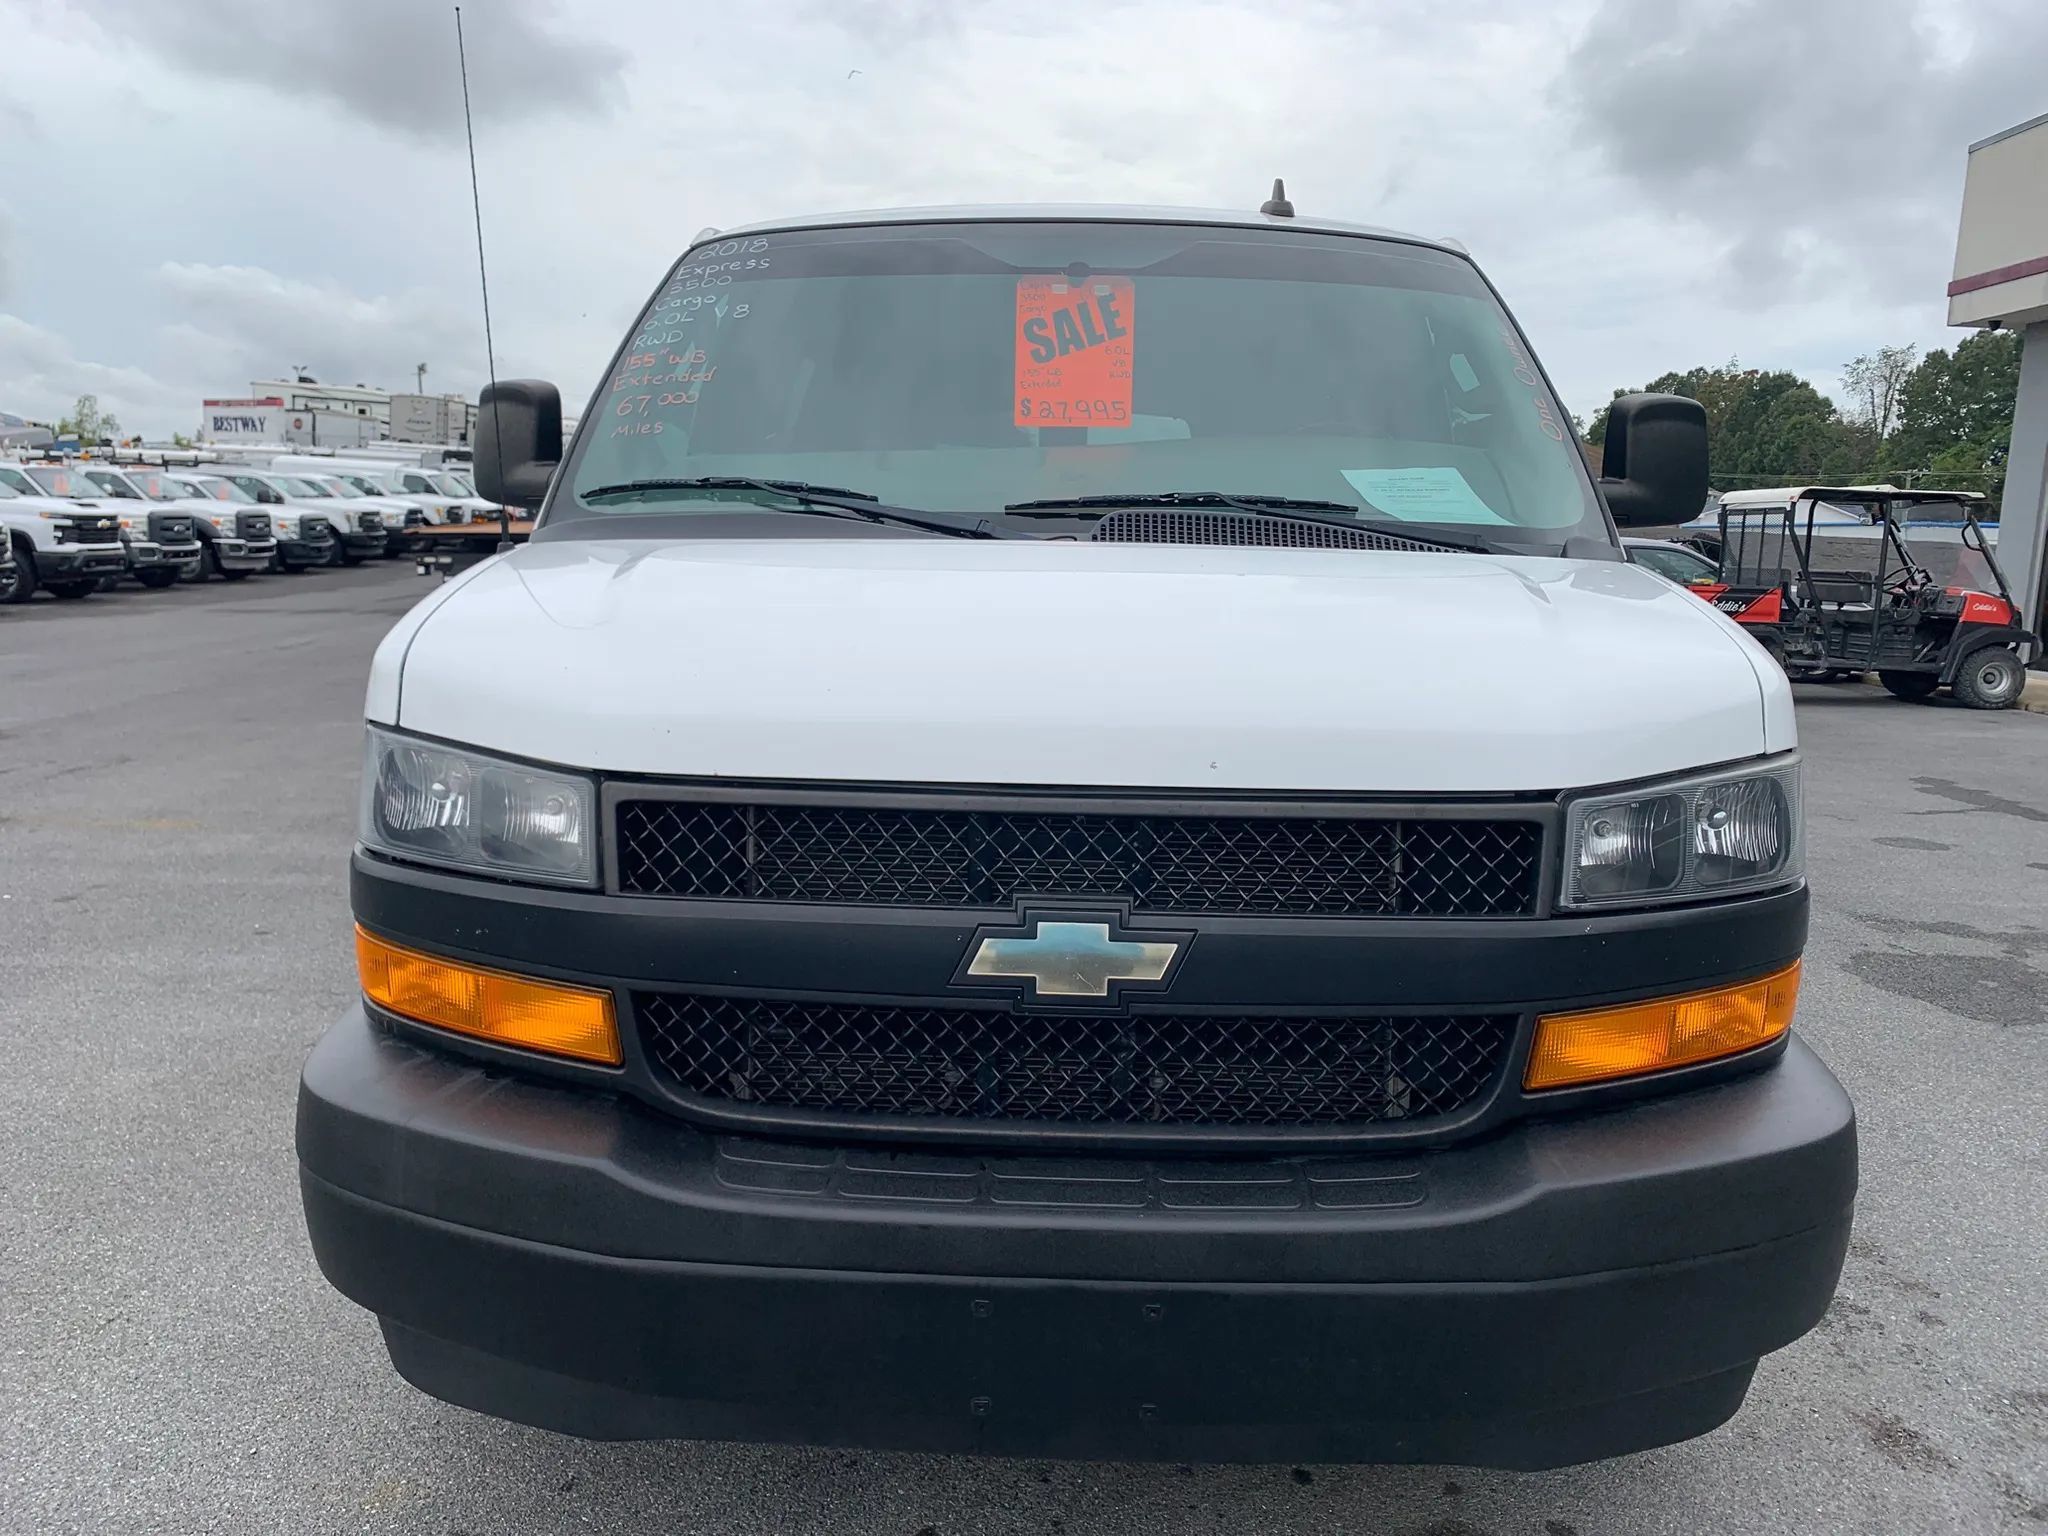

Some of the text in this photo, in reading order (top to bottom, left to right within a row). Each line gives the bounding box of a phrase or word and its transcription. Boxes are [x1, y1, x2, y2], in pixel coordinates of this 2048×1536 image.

[699, 238, 769, 260] 2018
[677, 259, 770, 280] Express
[655, 295, 717, 311] Cargo
[1023, 292, 1128, 364] SALE
[633, 330, 684, 351] RWD
[614, 367, 715, 391] Extended
[616, 390, 700, 417] 67,000
[1021, 397, 1127, 423] $ 27,995
[212, 415, 268, 433] BESTWAY
